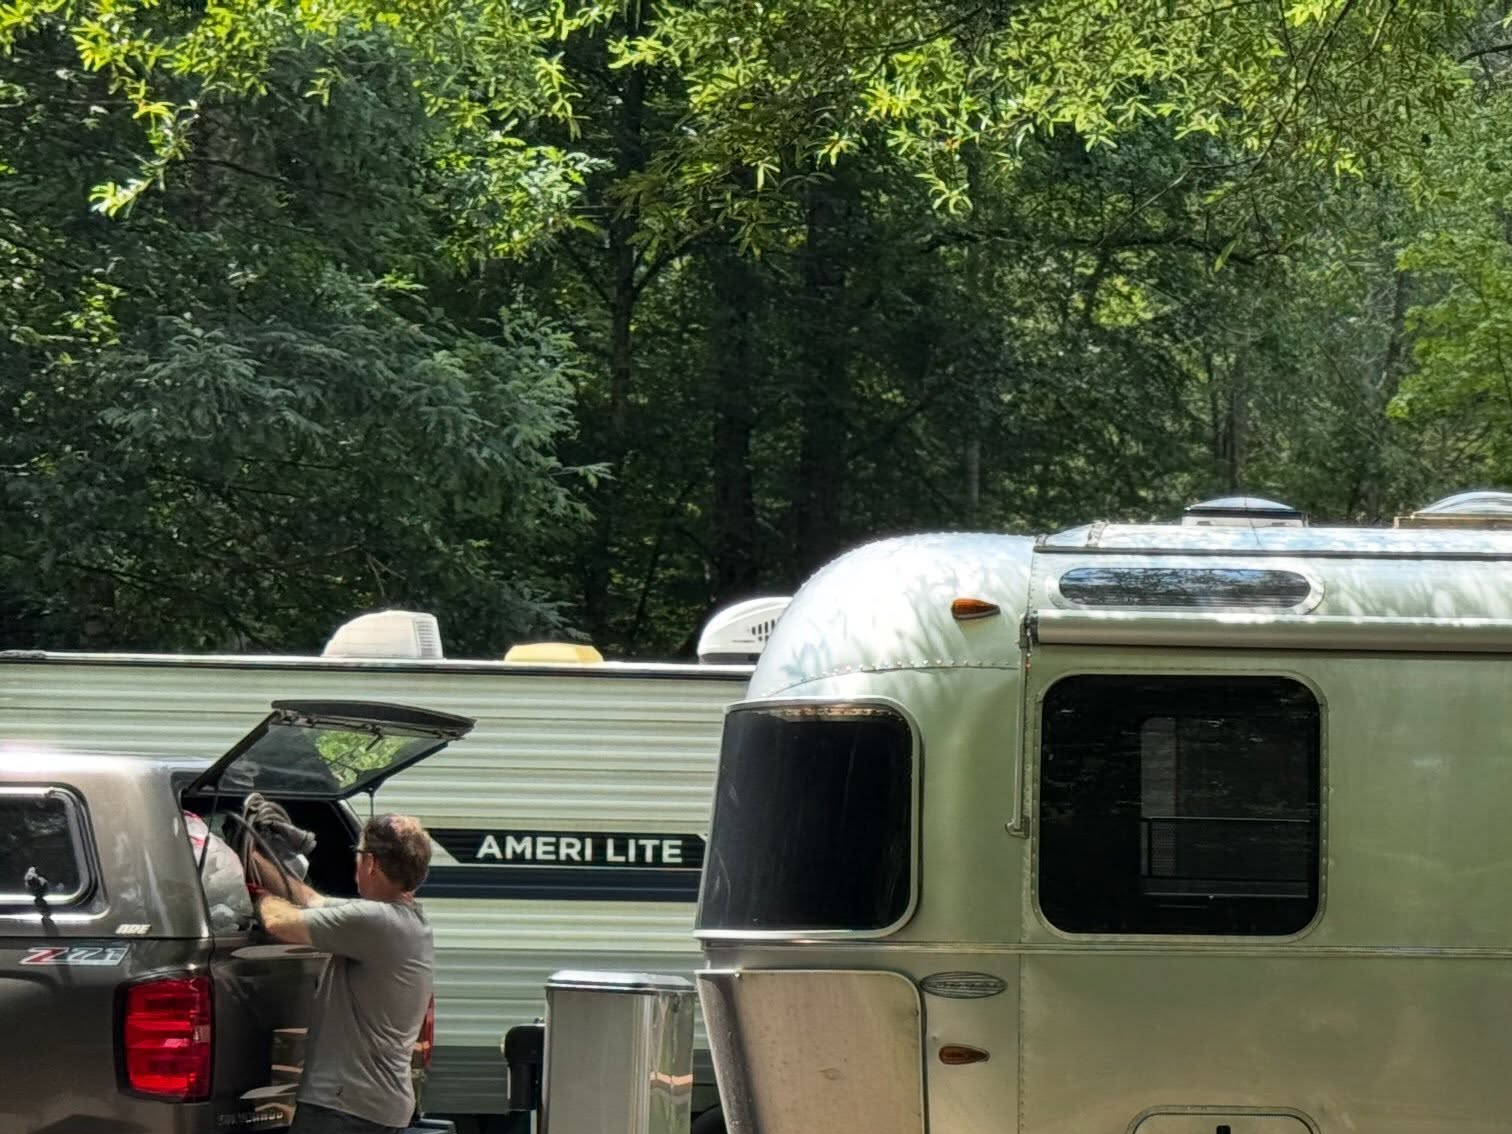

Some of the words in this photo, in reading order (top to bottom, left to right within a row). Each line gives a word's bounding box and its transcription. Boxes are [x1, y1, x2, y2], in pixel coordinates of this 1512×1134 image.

[476, 835, 593, 861] AMERI
[606, 838, 683, 863] LITE
[19, 946, 130, 965] Z71
